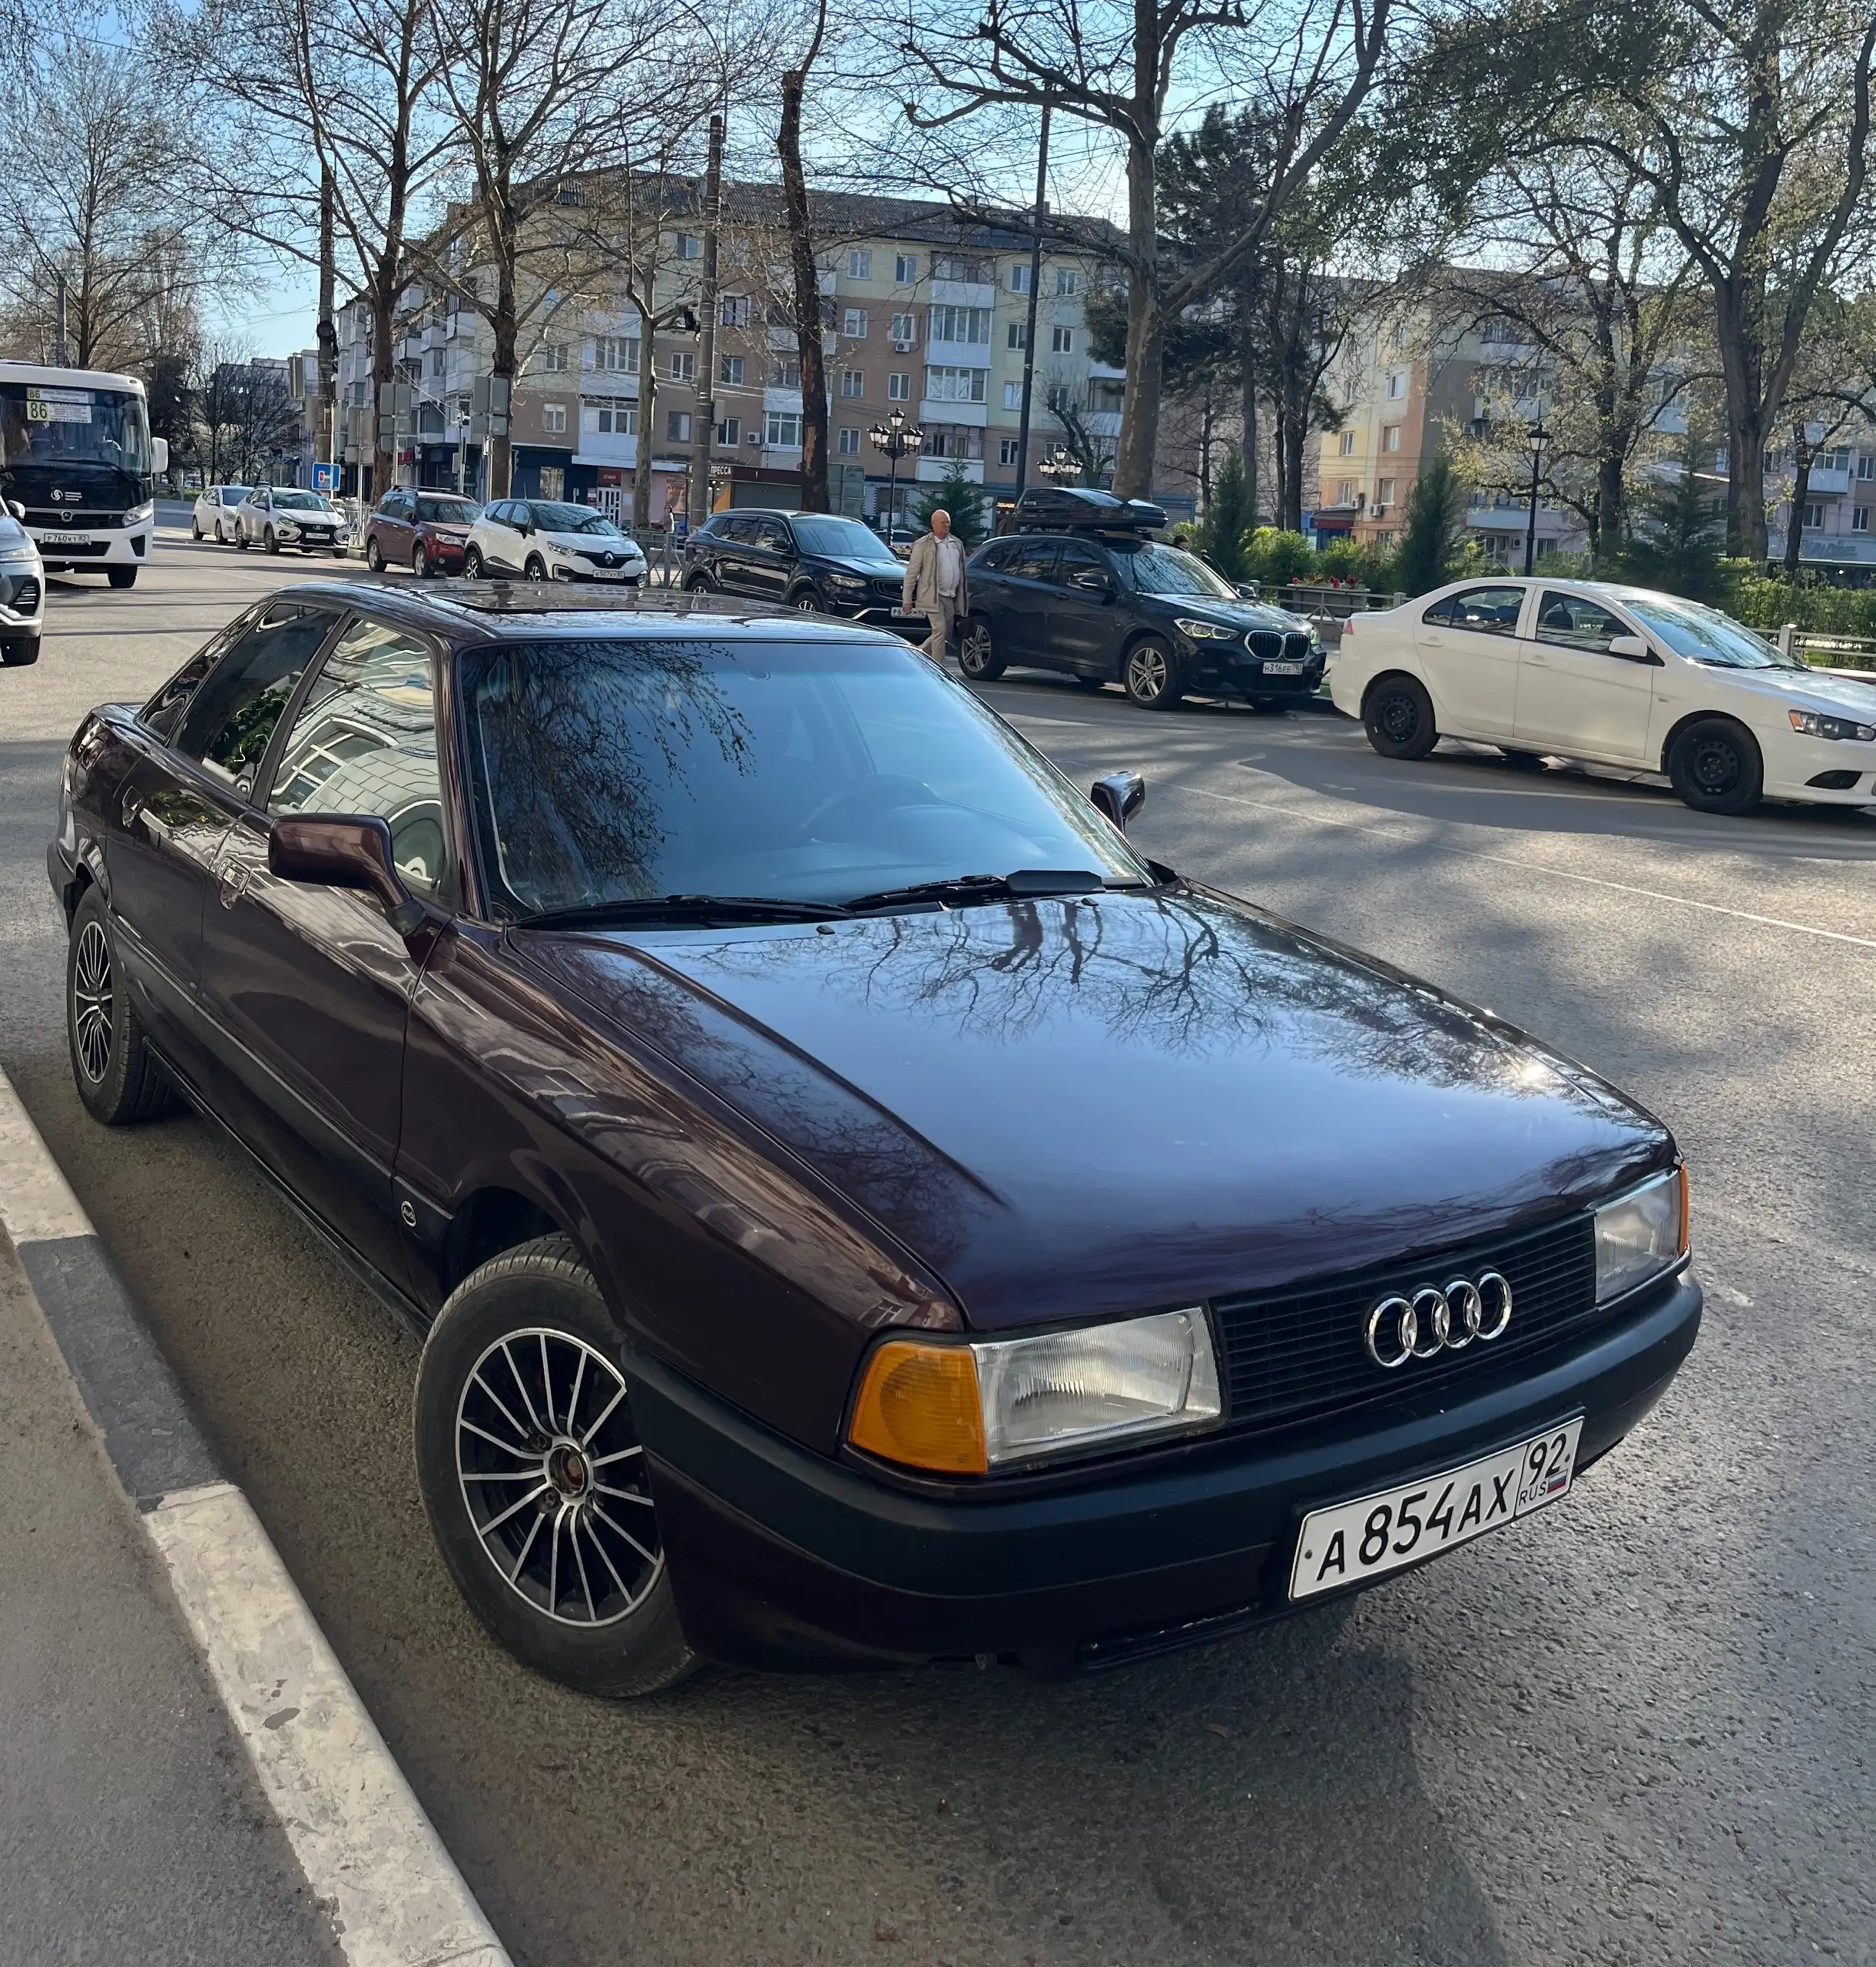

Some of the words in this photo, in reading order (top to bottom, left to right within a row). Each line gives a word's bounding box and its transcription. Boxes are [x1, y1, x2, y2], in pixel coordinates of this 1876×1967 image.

[31, 402, 48, 419] 86
[710, 465, 731, 475] ПРЕССА
[1264, 663, 1291, 673] Н316ЕЕ
[1518, 1480, 1546, 1508] RUS
[1316, 1468, 1514, 1581] А854АХ
[1528, 1432, 1568, 1487] 92
